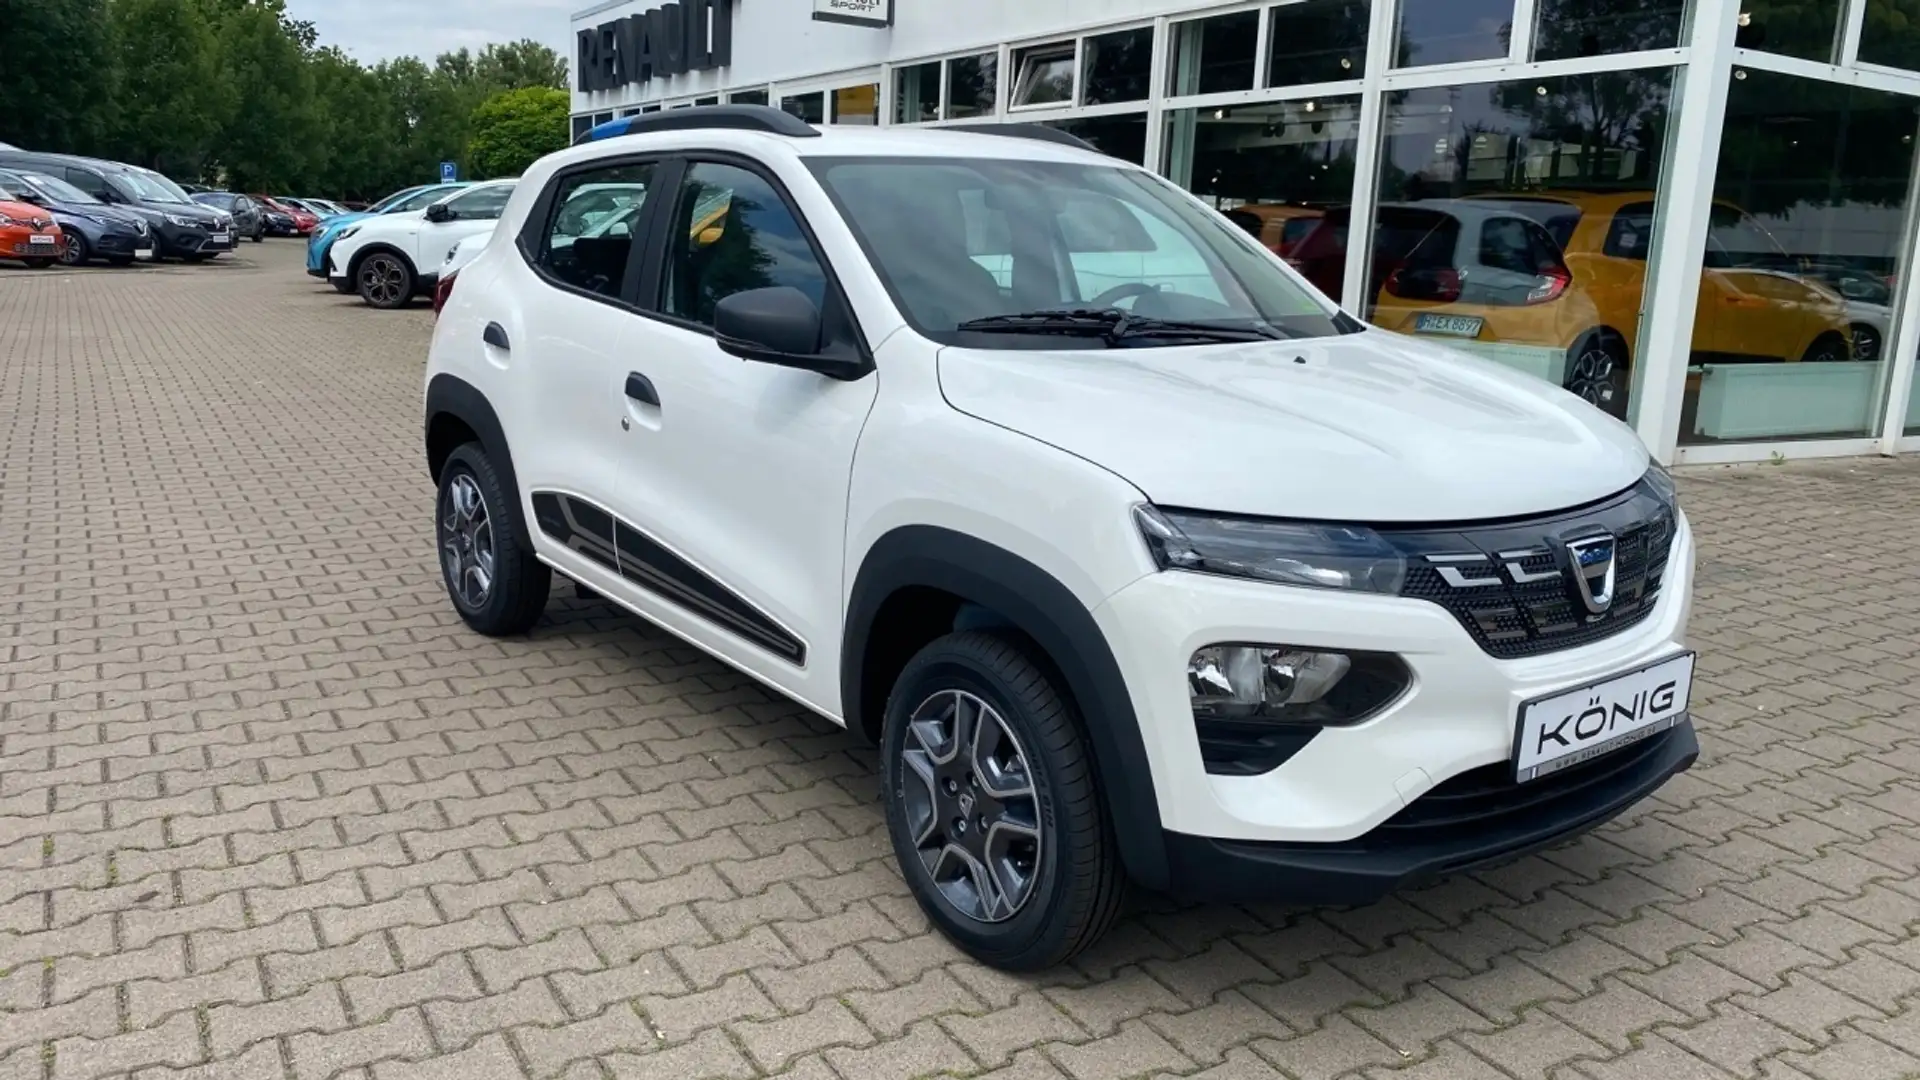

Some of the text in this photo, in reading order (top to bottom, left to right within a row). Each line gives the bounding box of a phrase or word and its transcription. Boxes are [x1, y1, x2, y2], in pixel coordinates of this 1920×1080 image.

[830, 0, 876, 12] SPORT
[577, 0, 733, 92] RENAULT
[1537, 680, 1676, 755] KÖNIG
